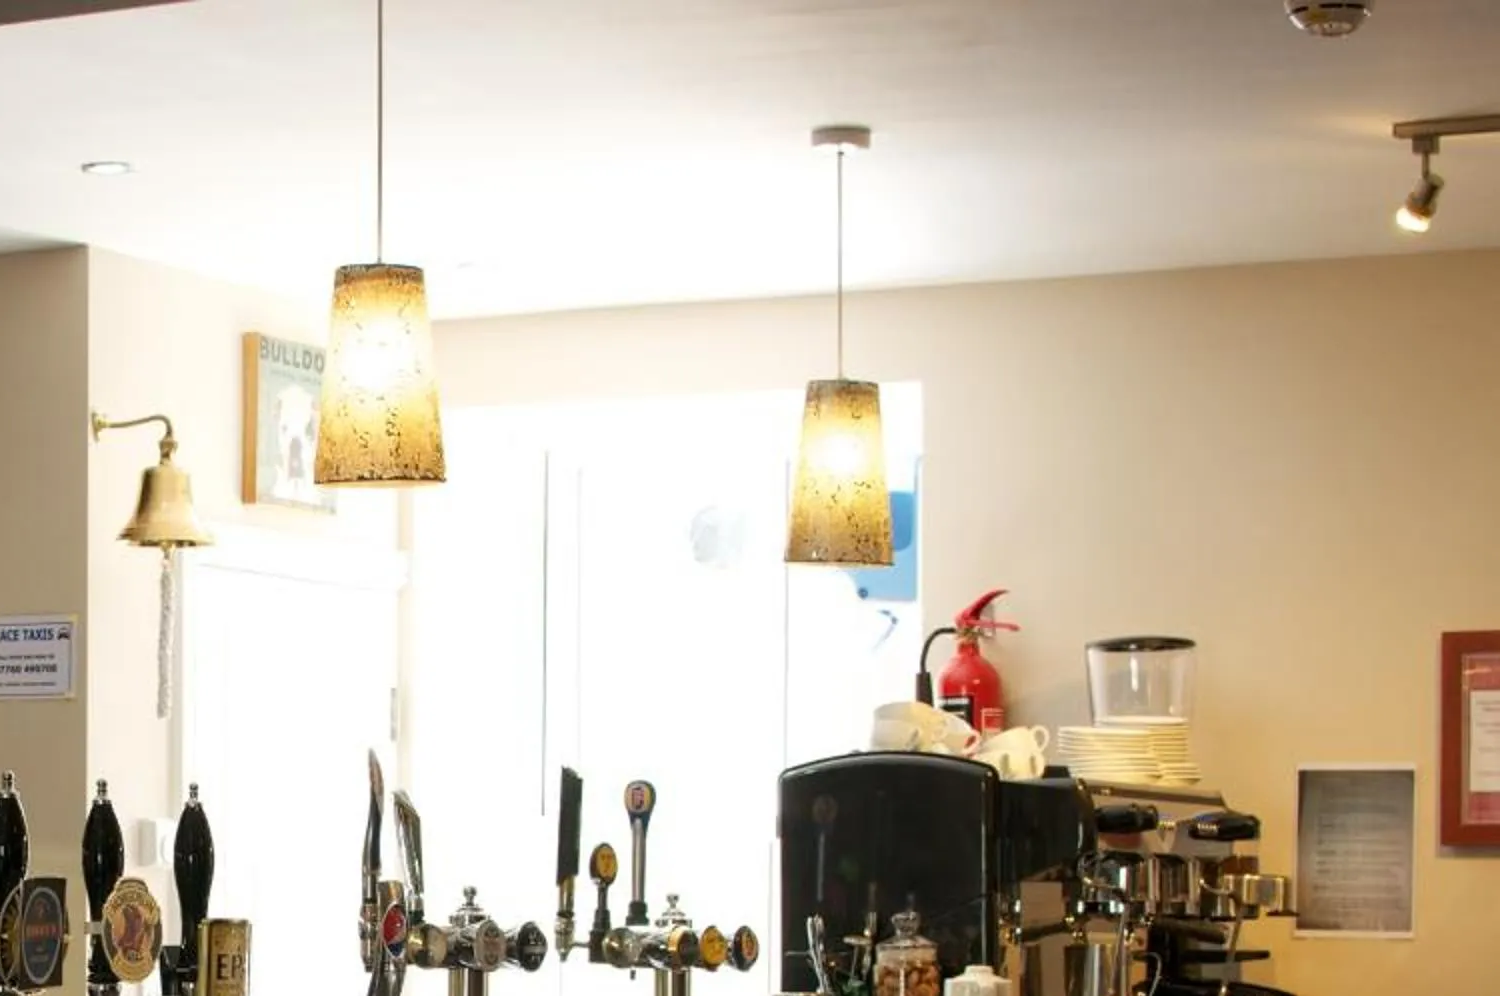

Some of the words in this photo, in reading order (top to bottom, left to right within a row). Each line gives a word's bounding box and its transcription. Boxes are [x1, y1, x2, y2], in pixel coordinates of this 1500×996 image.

[260, 335, 326, 375] BULLDO
[0, 629, 20, 641] ACE
[23, 628, 54, 640] TAXIS
[217, 953, 245, 979] EP
